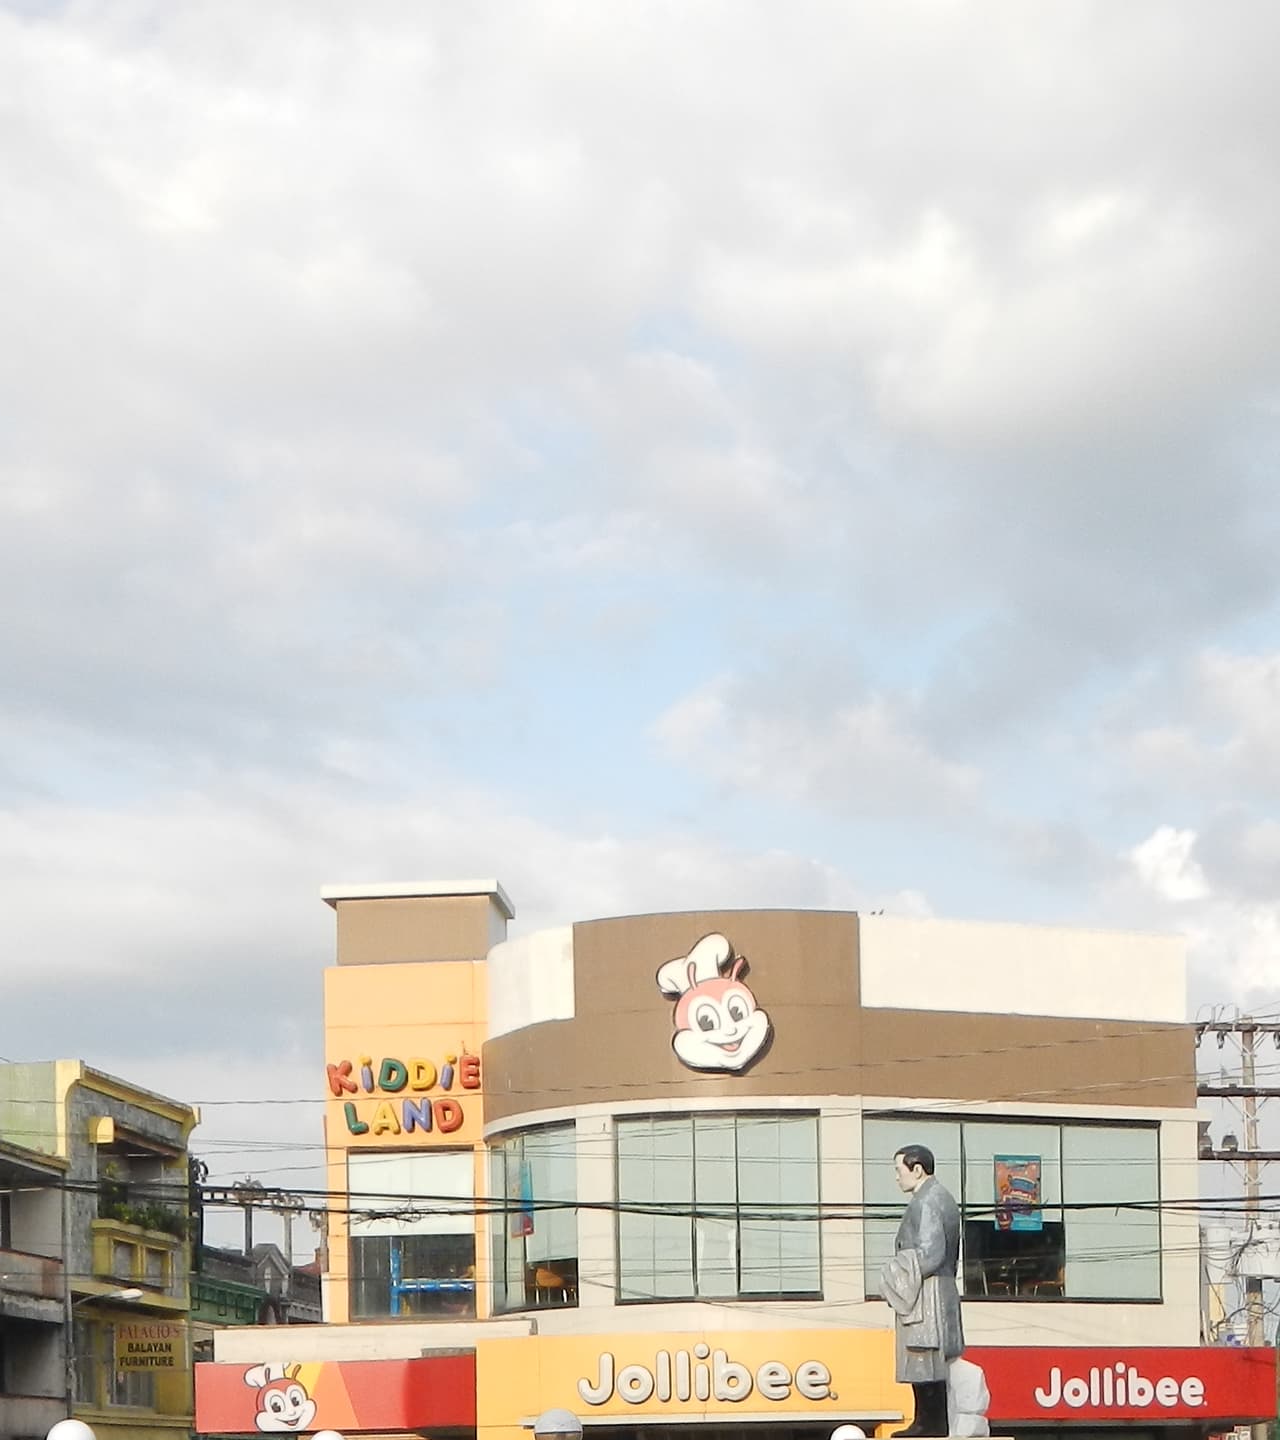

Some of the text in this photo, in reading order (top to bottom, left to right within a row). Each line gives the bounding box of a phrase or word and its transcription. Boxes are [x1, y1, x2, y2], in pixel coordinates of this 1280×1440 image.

[343, 1097, 464, 1135] LAND
[120, 1356, 175, 1367] FURNITURE
[128, 1342, 172, 1353] BALAYAN
[577, 1342, 832, 1406] Jollibee
[1034, 1361, 1205, 1408] Jollibee
